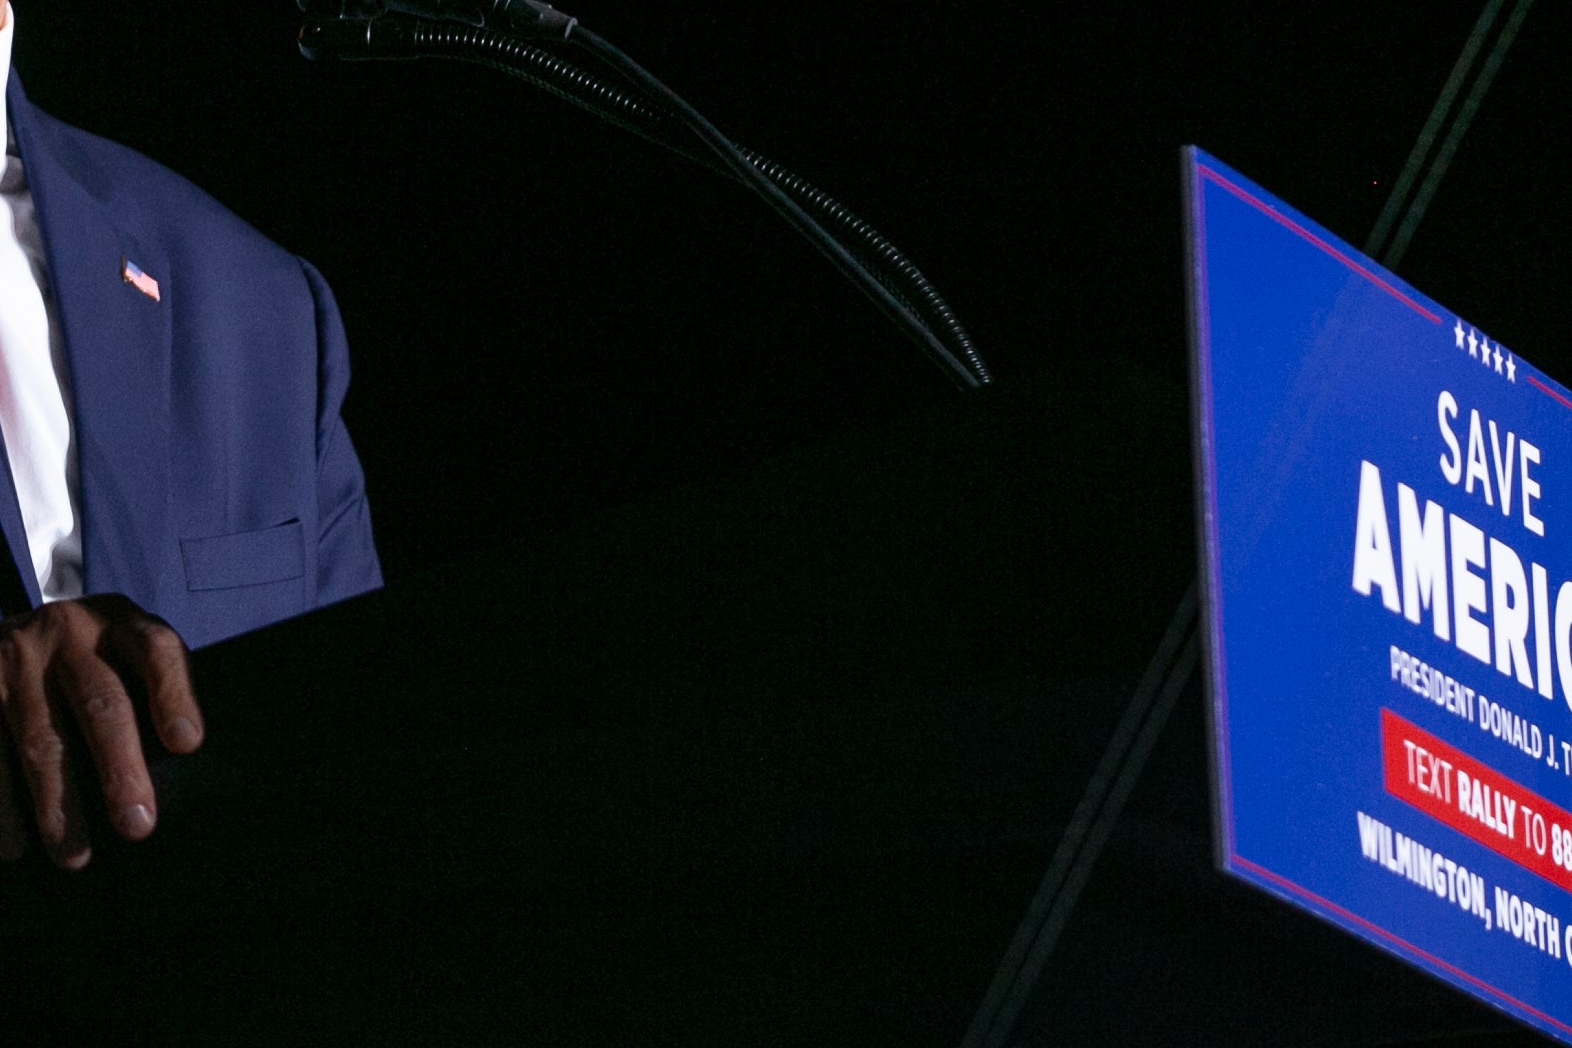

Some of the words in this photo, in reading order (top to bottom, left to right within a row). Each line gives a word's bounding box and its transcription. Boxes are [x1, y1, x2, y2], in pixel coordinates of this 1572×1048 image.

[1438, 390, 1545, 537] SAVE
[1390, 644, 1475, 722] PRESIDENT
[1479, 695, 1543, 759] DONALD
[1546, 734, 1560, 770] J.
[1561, 741, 1572, 776] T
[1404, 739, 1452, 804] TEXT
[1457, 770, 1516, 839] RALLY
[1521, 805, 1547, 855] TO
[1357, 810, 1491, 931] WILMINGTON,
[1495, 886, 1561, 959] NORTH
